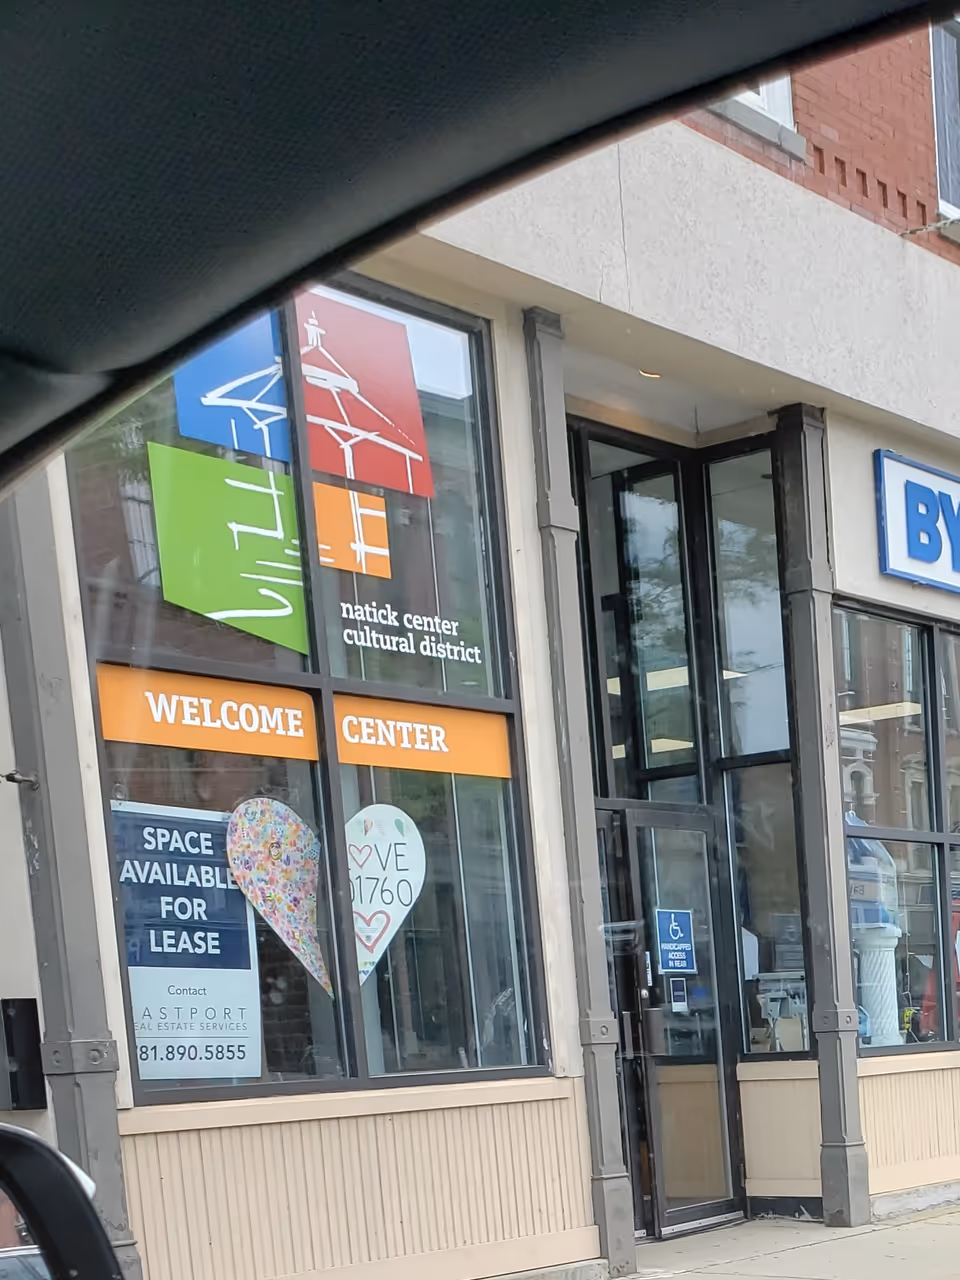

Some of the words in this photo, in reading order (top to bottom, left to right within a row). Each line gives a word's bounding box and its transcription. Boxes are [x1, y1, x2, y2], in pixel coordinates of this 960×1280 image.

[340, 601, 399, 627] natick
[403, 612, 459, 636] center
[343, 626, 416, 654] cultural
[420, 635, 482, 664] district
[145, 691, 304, 738] WELCOME
[342, 715, 449, 753] CENTER
[143, 826, 214, 855] SPACE
[119, 860, 239, 890] AVAILABLE
[160, 896, 208, 921] FOR
[150, 930, 221, 954] LEASE
[167, 985, 207, 996] Contact
[140, 1007, 247, 1020] ASTPORT
[134, 1022, 152, 1031] EAL
[157, 1022, 195, 1031] ESTATE
[200, 1022, 247, 1032] SERVICES
[136, 1045, 246, 1061] 81.890.5855
